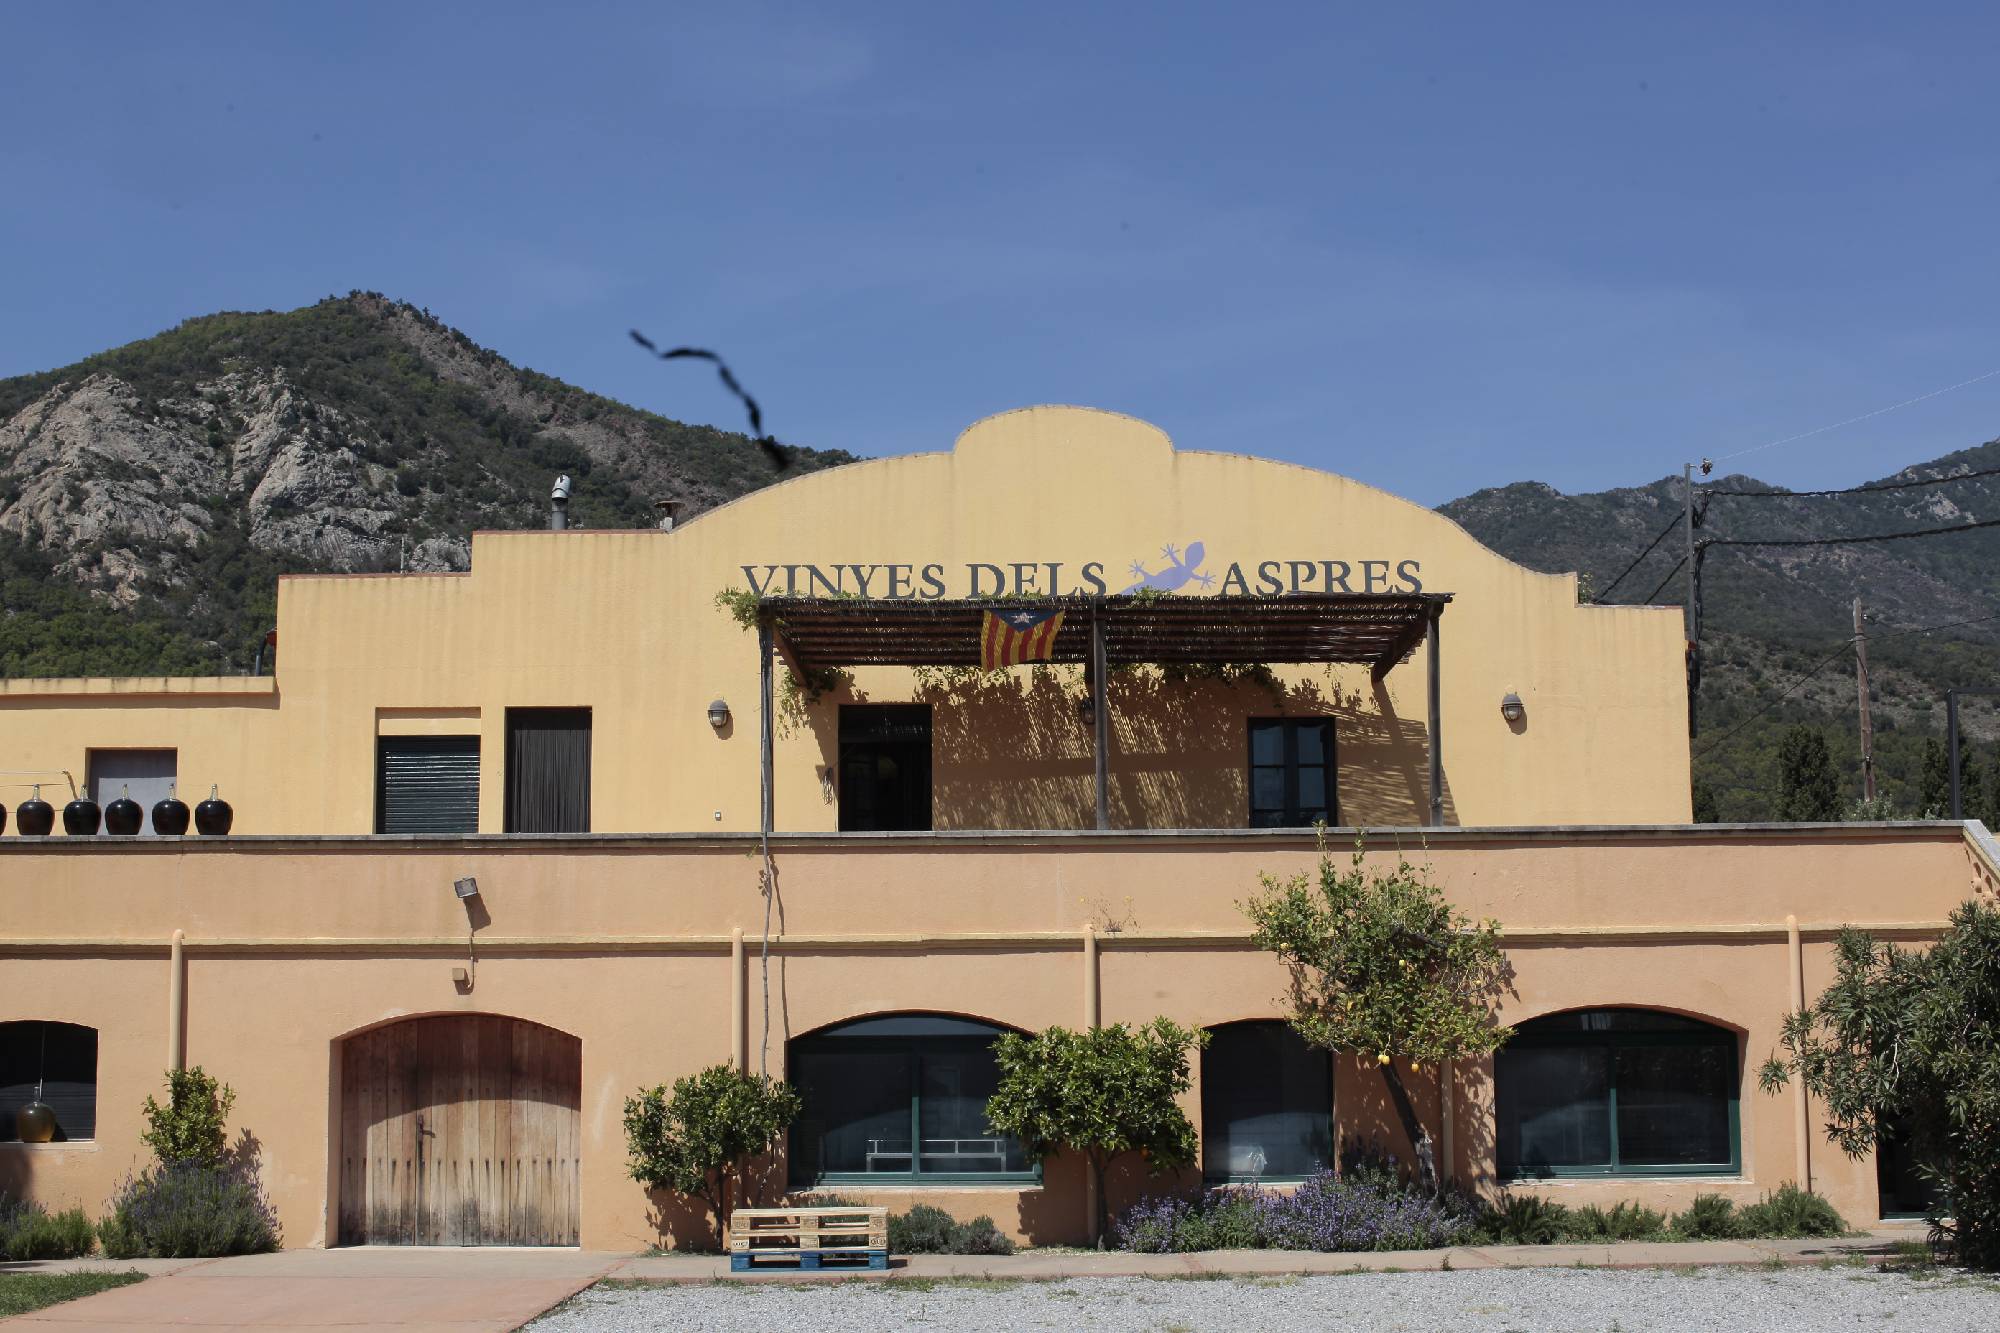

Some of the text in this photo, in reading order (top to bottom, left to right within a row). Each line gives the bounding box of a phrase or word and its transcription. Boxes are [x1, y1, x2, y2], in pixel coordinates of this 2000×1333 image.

[740, 560, 1424, 600] VINYES DELS ASPRES
